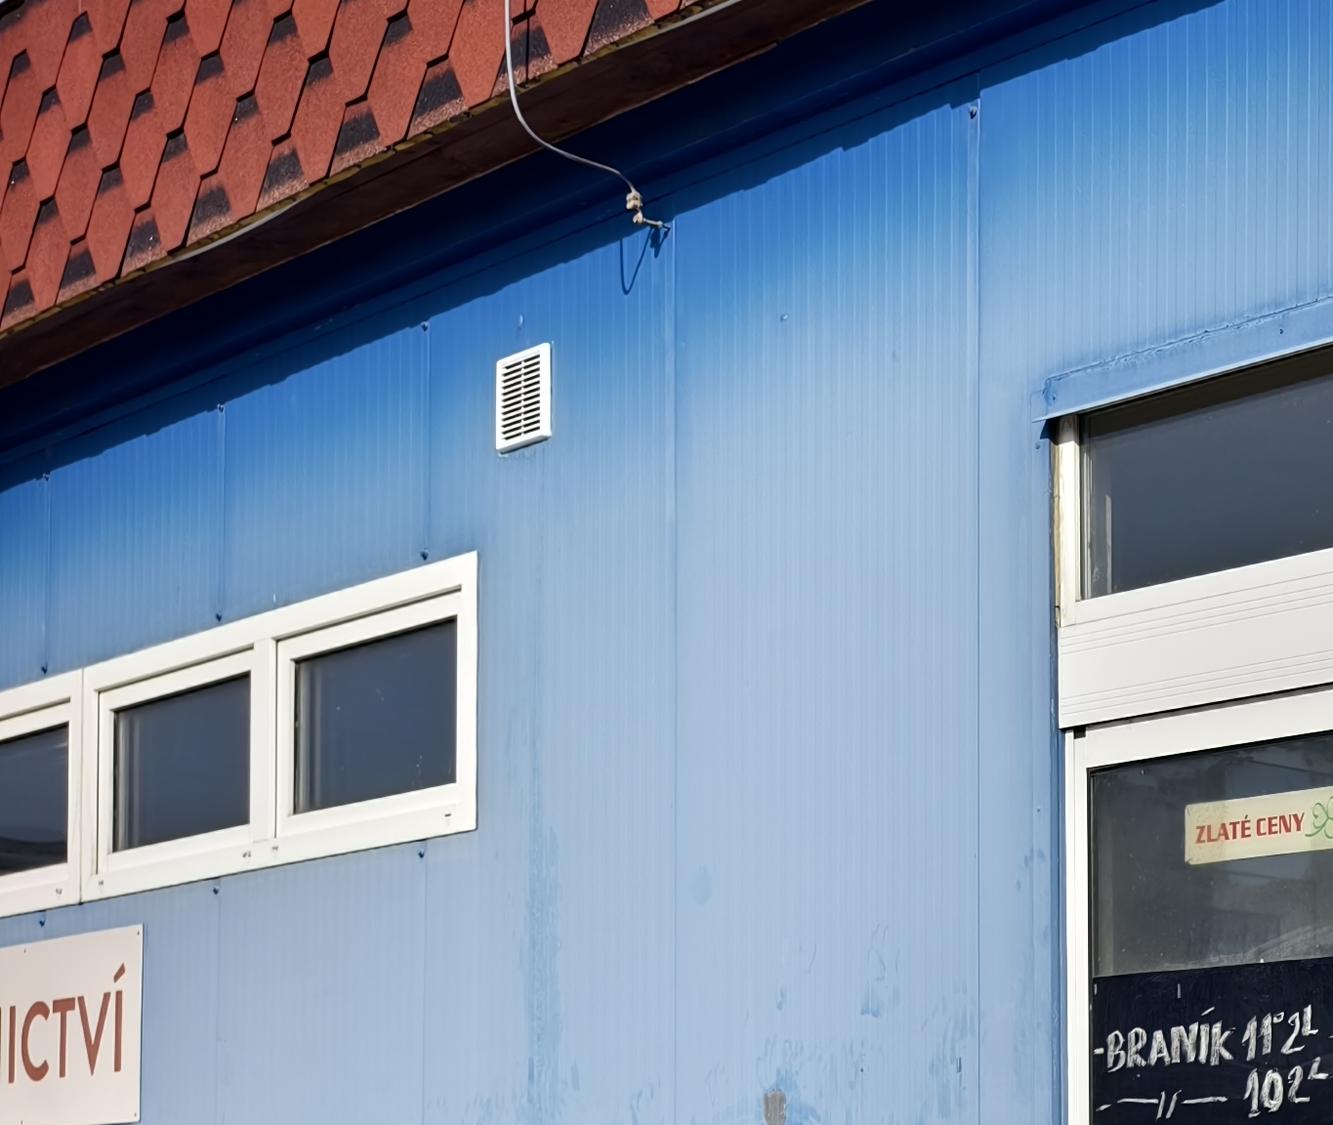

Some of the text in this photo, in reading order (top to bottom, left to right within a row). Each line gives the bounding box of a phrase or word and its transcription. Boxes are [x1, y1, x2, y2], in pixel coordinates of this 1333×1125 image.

[1195, 812, 1305, 844] ZLATÉ CENY
[0, 962, 126, 1084] ICTVÍ
